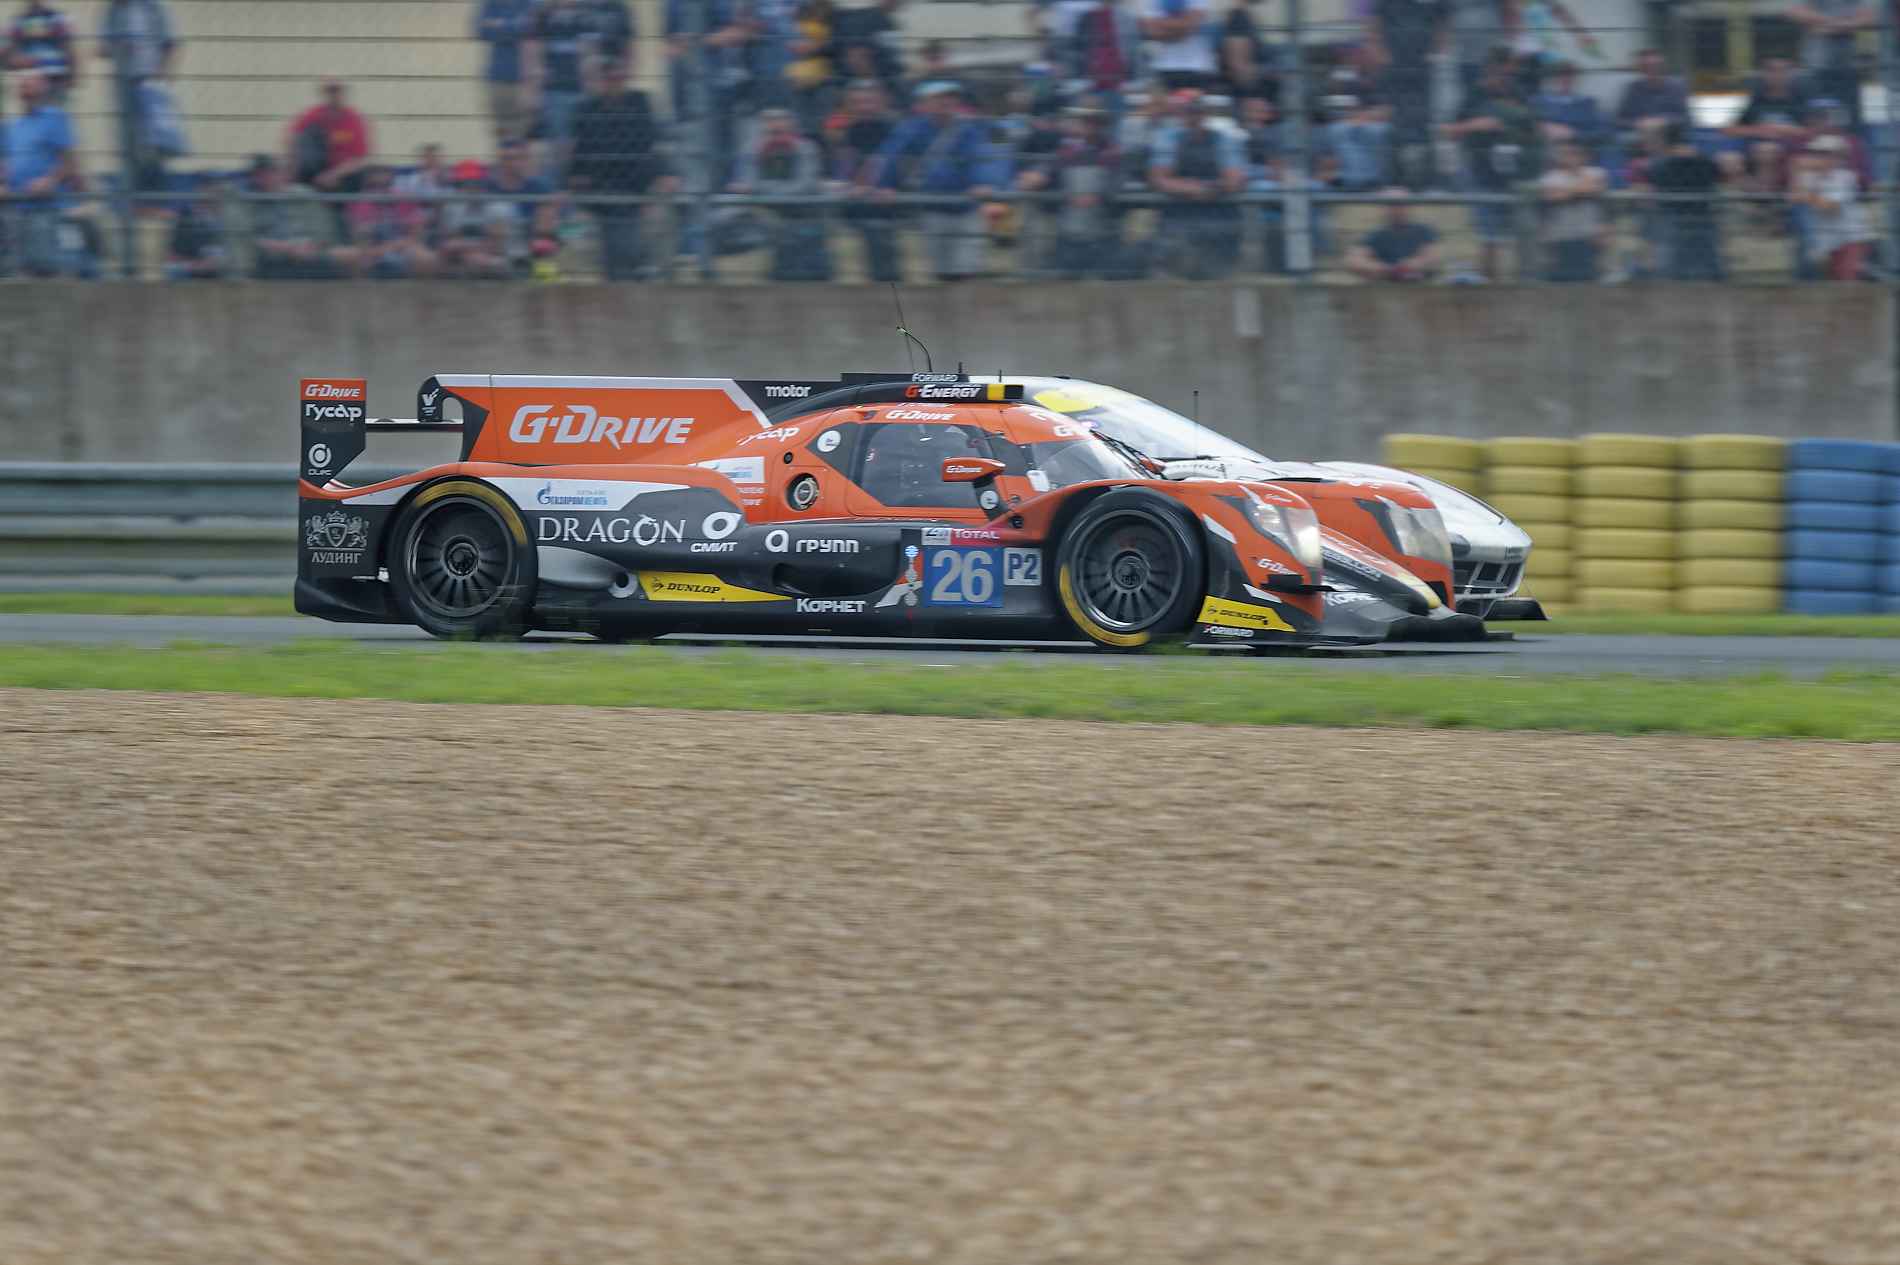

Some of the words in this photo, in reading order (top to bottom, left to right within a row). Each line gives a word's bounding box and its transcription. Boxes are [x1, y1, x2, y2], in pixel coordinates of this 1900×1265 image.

[305, 384, 361, 398] G-DRIVE
[765, 385, 812, 397] motor
[904, 384, 982, 399] G-ENERGY
[886, 410, 956, 420] G-DRIVE
[508, 404, 696, 450] G-DRIVE
[536, 514, 687, 546] DRAGON
[952, 528, 1000, 539] TOTAL
[1008, 553, 1038, 580] P2
[931, 549, 994, 603] 26
[667, 583, 721, 594] DUNLOP
